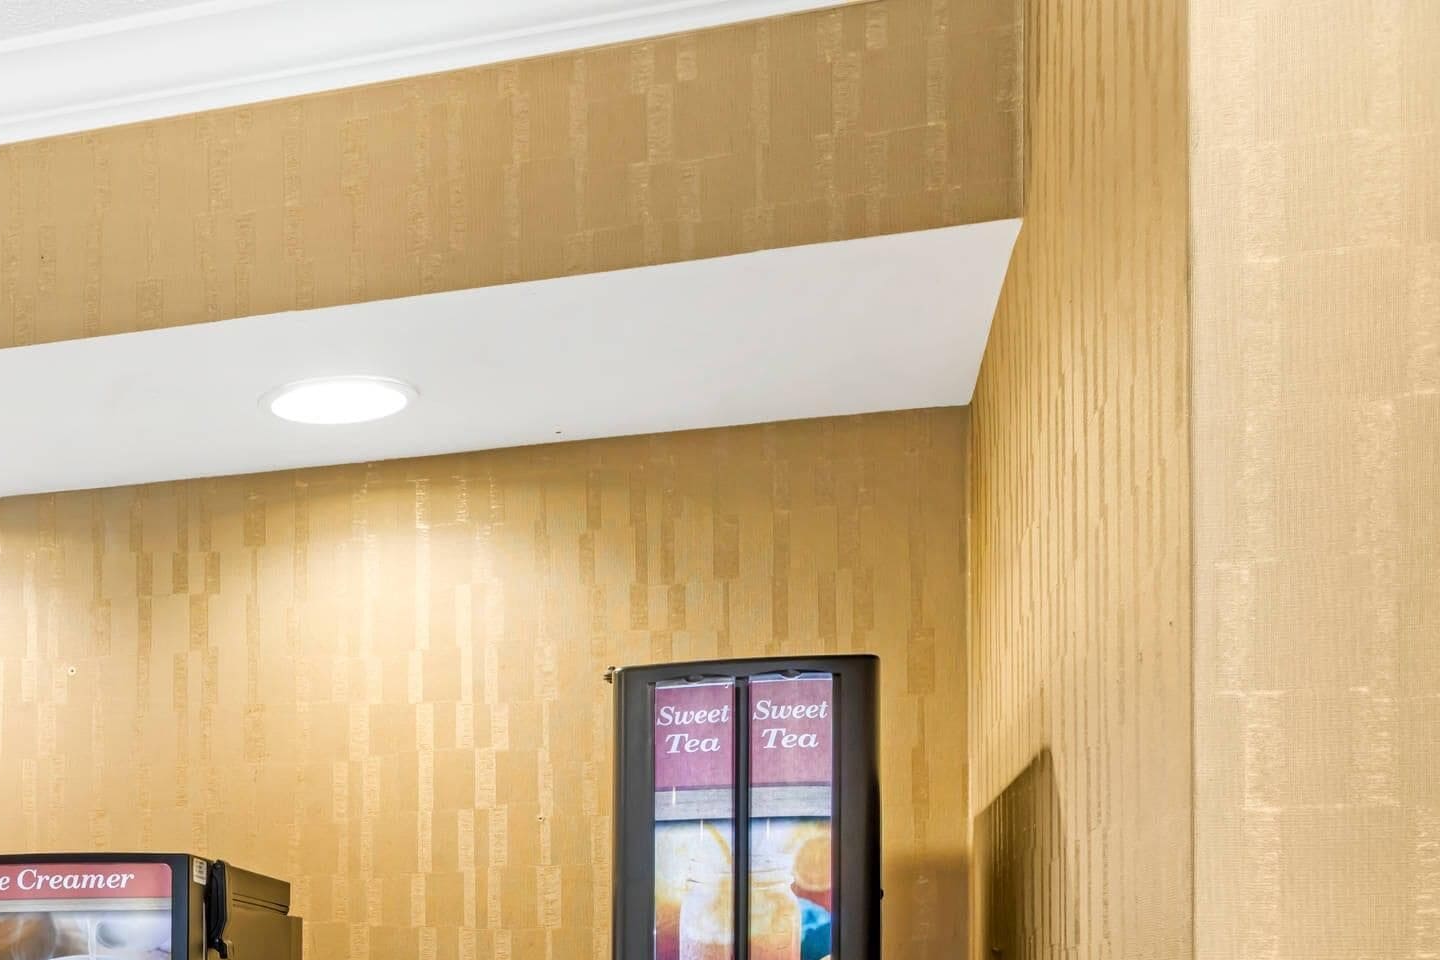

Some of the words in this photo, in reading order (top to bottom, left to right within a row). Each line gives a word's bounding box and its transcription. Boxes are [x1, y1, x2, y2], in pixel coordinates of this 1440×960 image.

[656, 704, 731, 726] Sweet
[752, 699, 829, 721] Sweet
[665, 733, 721, 754] Tea
[761, 727, 820, 750] Tea
[16, 868, 135, 891] Creamer
